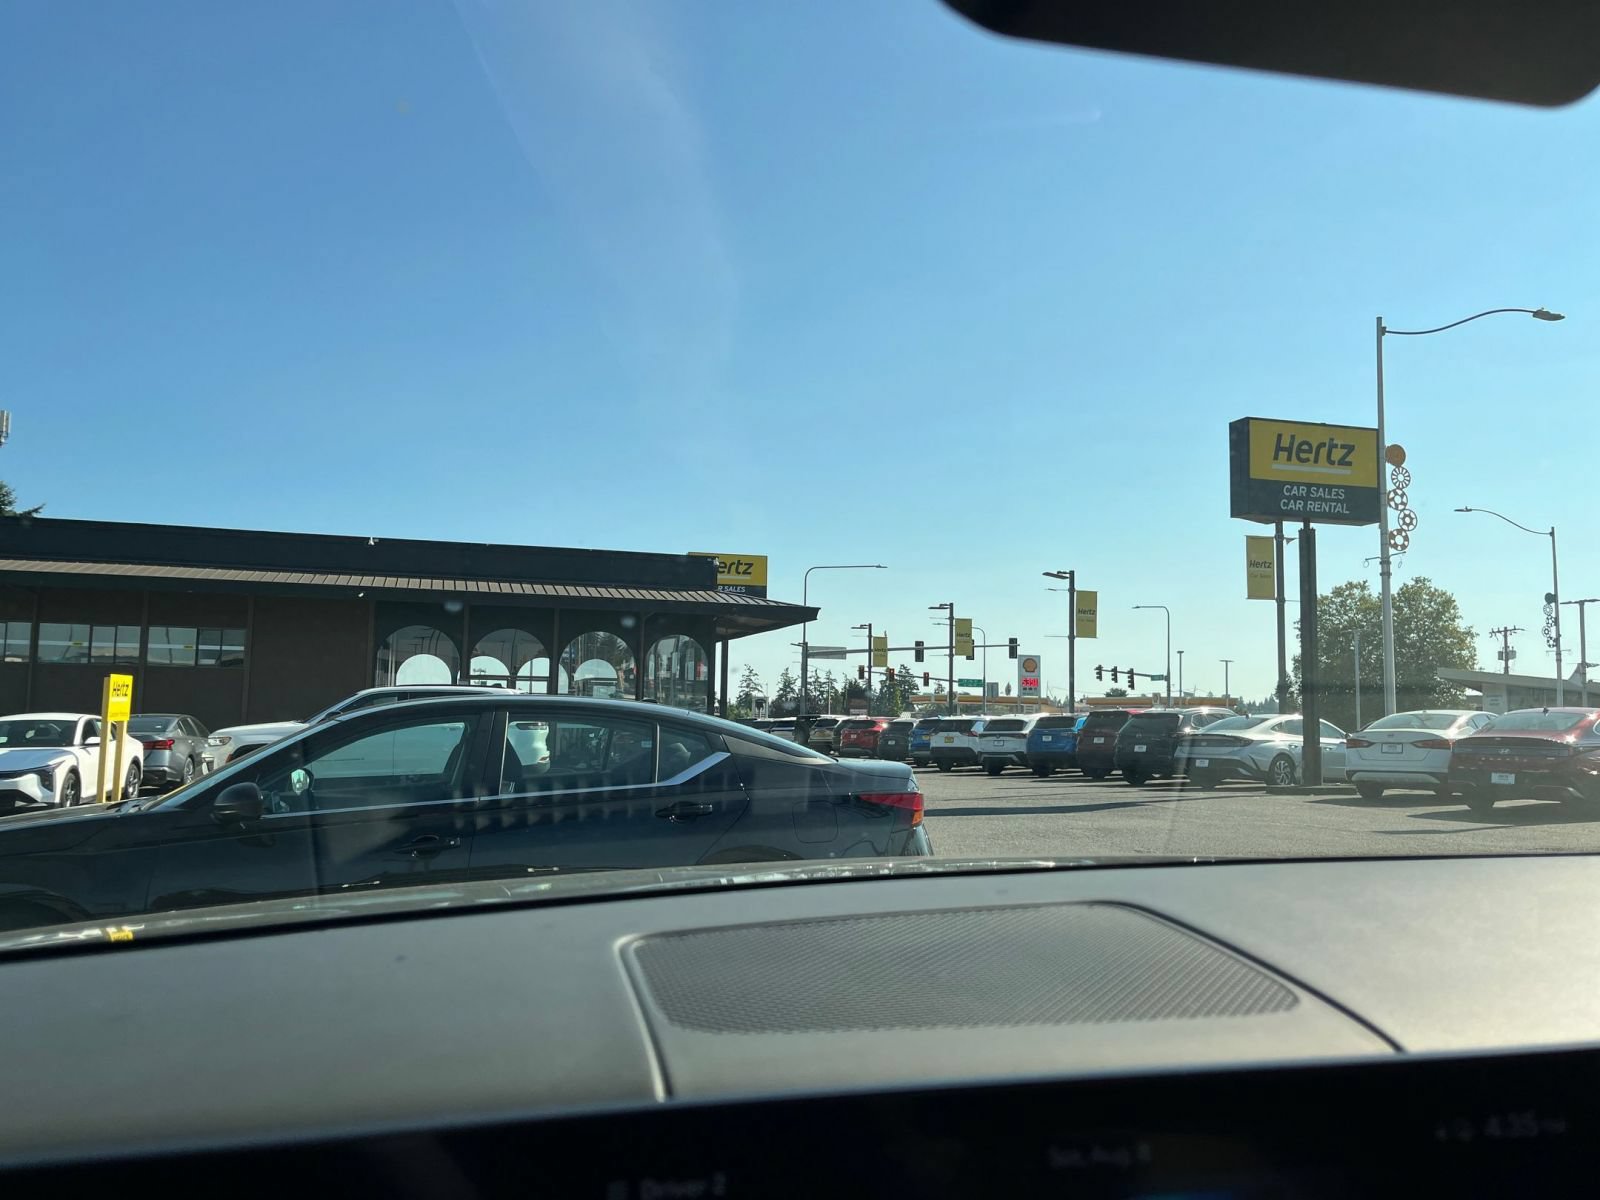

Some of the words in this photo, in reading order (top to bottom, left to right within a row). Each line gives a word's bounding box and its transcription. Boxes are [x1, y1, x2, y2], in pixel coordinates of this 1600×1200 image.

[1272, 433, 1355, 467] Hertz
[1283, 484, 1306, 497] CAR
[1309, 486, 1345, 500] SALES
[1280, 499, 1304, 511] CAR
[1306, 501, 1350, 514] RENTAL
[717, 560, 754, 575] ertz
[1249, 559, 1273, 569] Hertz
[724, 585, 746, 593] SALES
